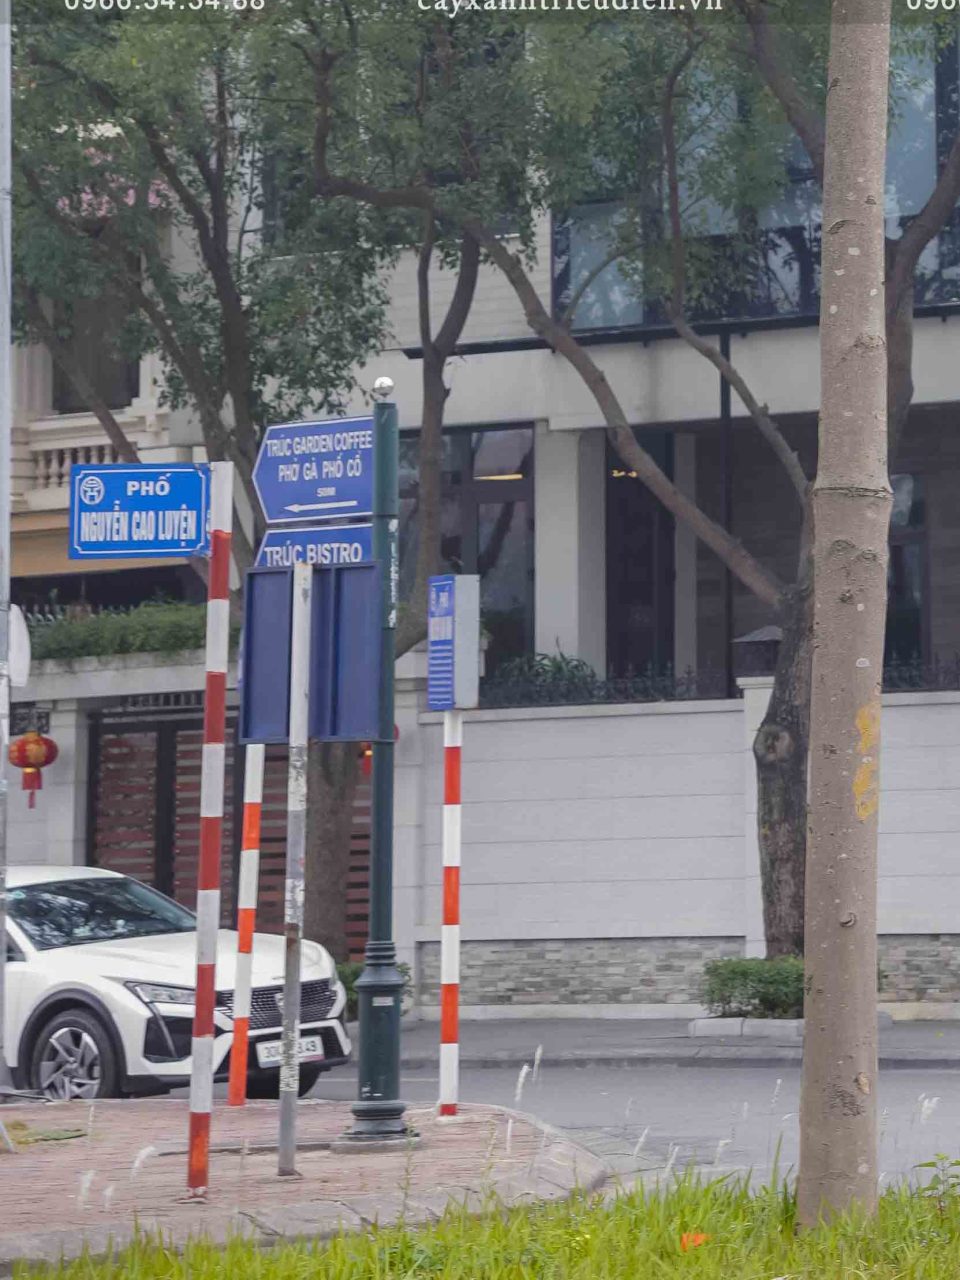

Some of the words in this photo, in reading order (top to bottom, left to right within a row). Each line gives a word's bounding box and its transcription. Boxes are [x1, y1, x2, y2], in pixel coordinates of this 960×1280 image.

[266, 434, 292, 457] TRÚC
[293, 434, 334, 455] GARDEN
[334, 430, 373, 451] COFFEE
[302, 457, 318, 480] GÀ
[322, 452, 344, 479] PHỐ
[126, 472, 172, 496] PHỐ
[131, 510, 156, 541] CAO
[158, 503, 197, 548] LUYỆN
[264, 540, 303, 567] TRÚC
[306, 542, 363, 565] BISTRO
